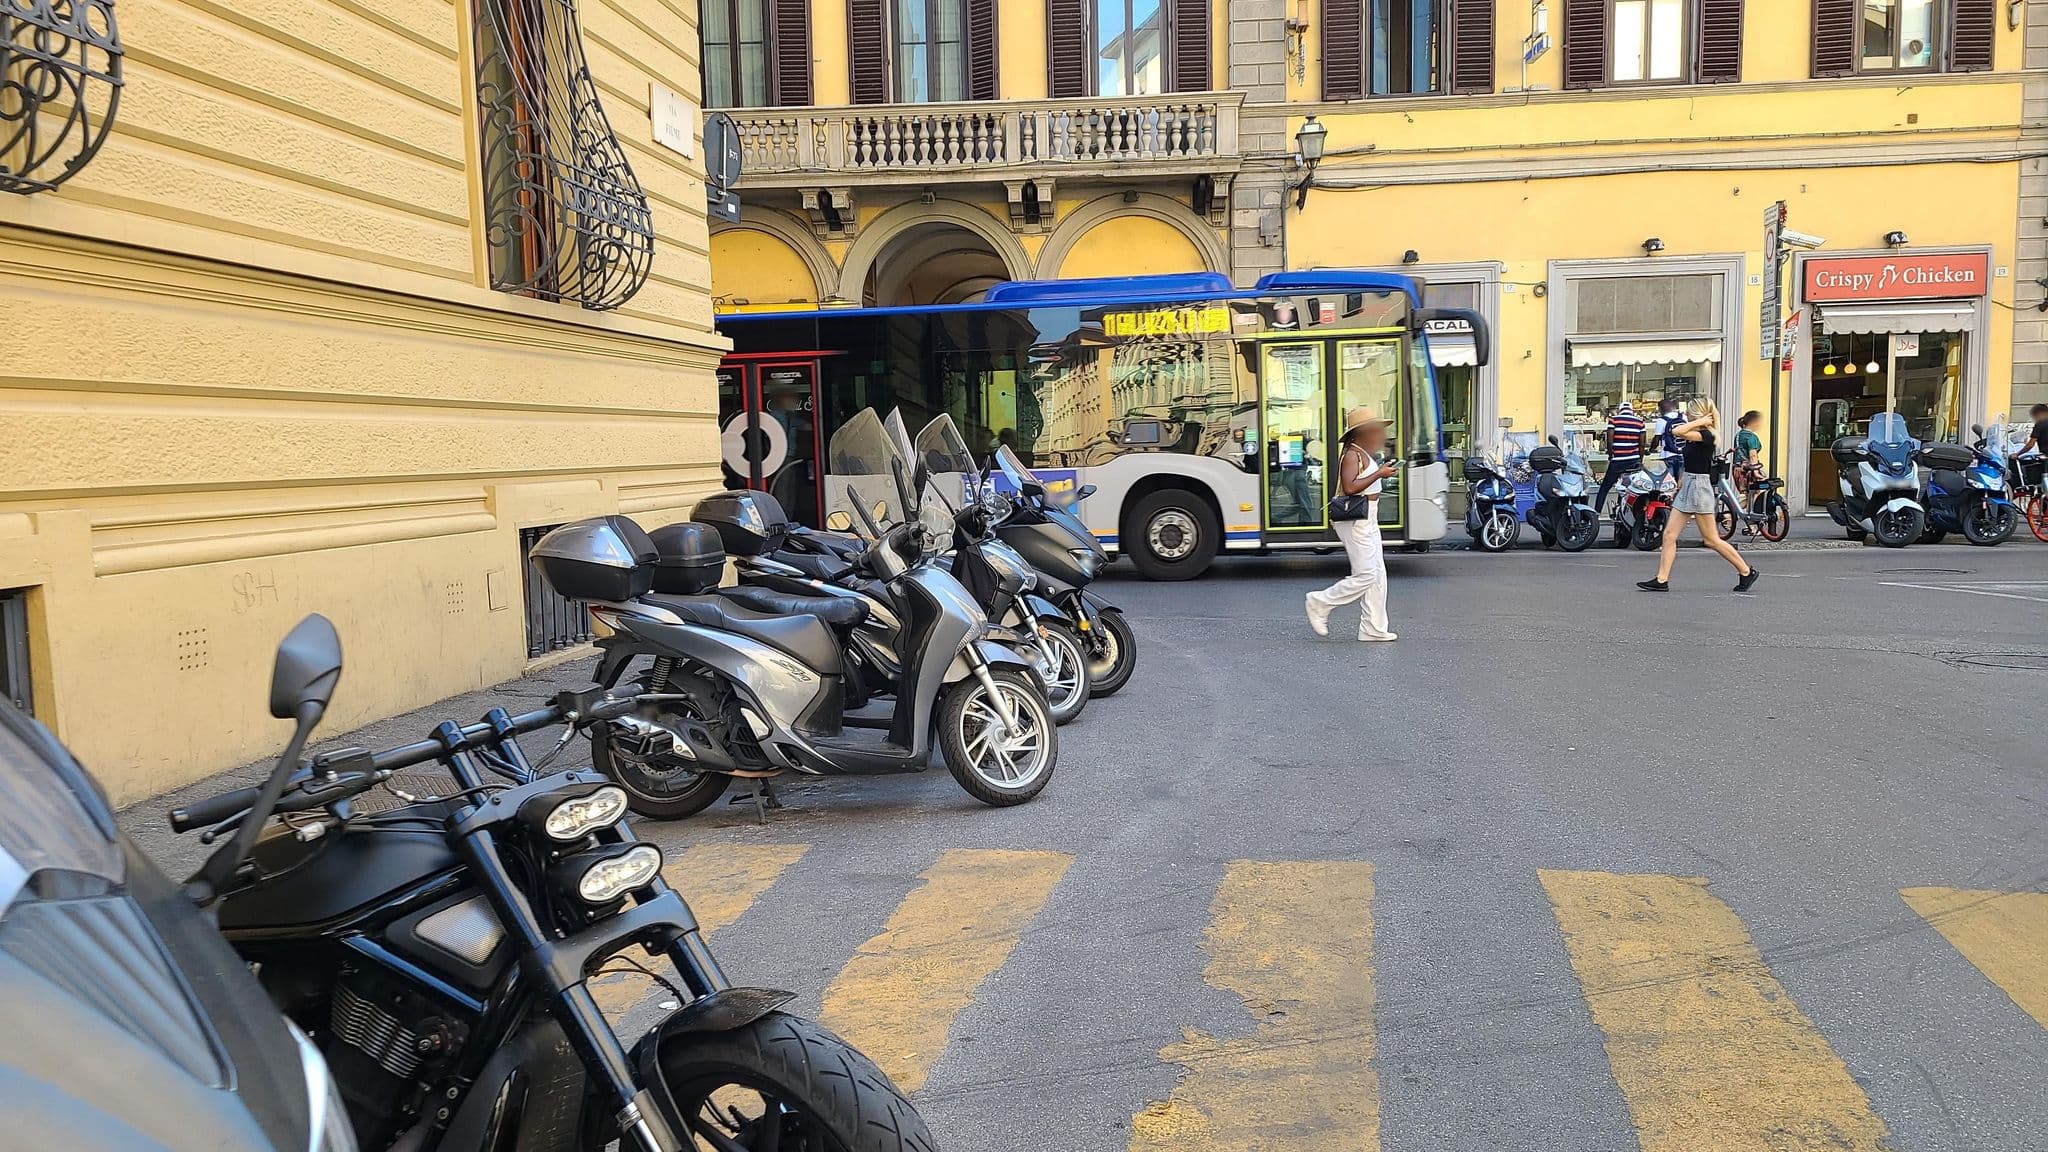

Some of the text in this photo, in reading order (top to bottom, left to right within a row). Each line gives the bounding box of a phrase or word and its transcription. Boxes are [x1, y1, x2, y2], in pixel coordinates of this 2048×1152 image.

[1815, 265, 1976, 291] Crispy Chicken
[1424, 320, 1473, 330] ACAL
